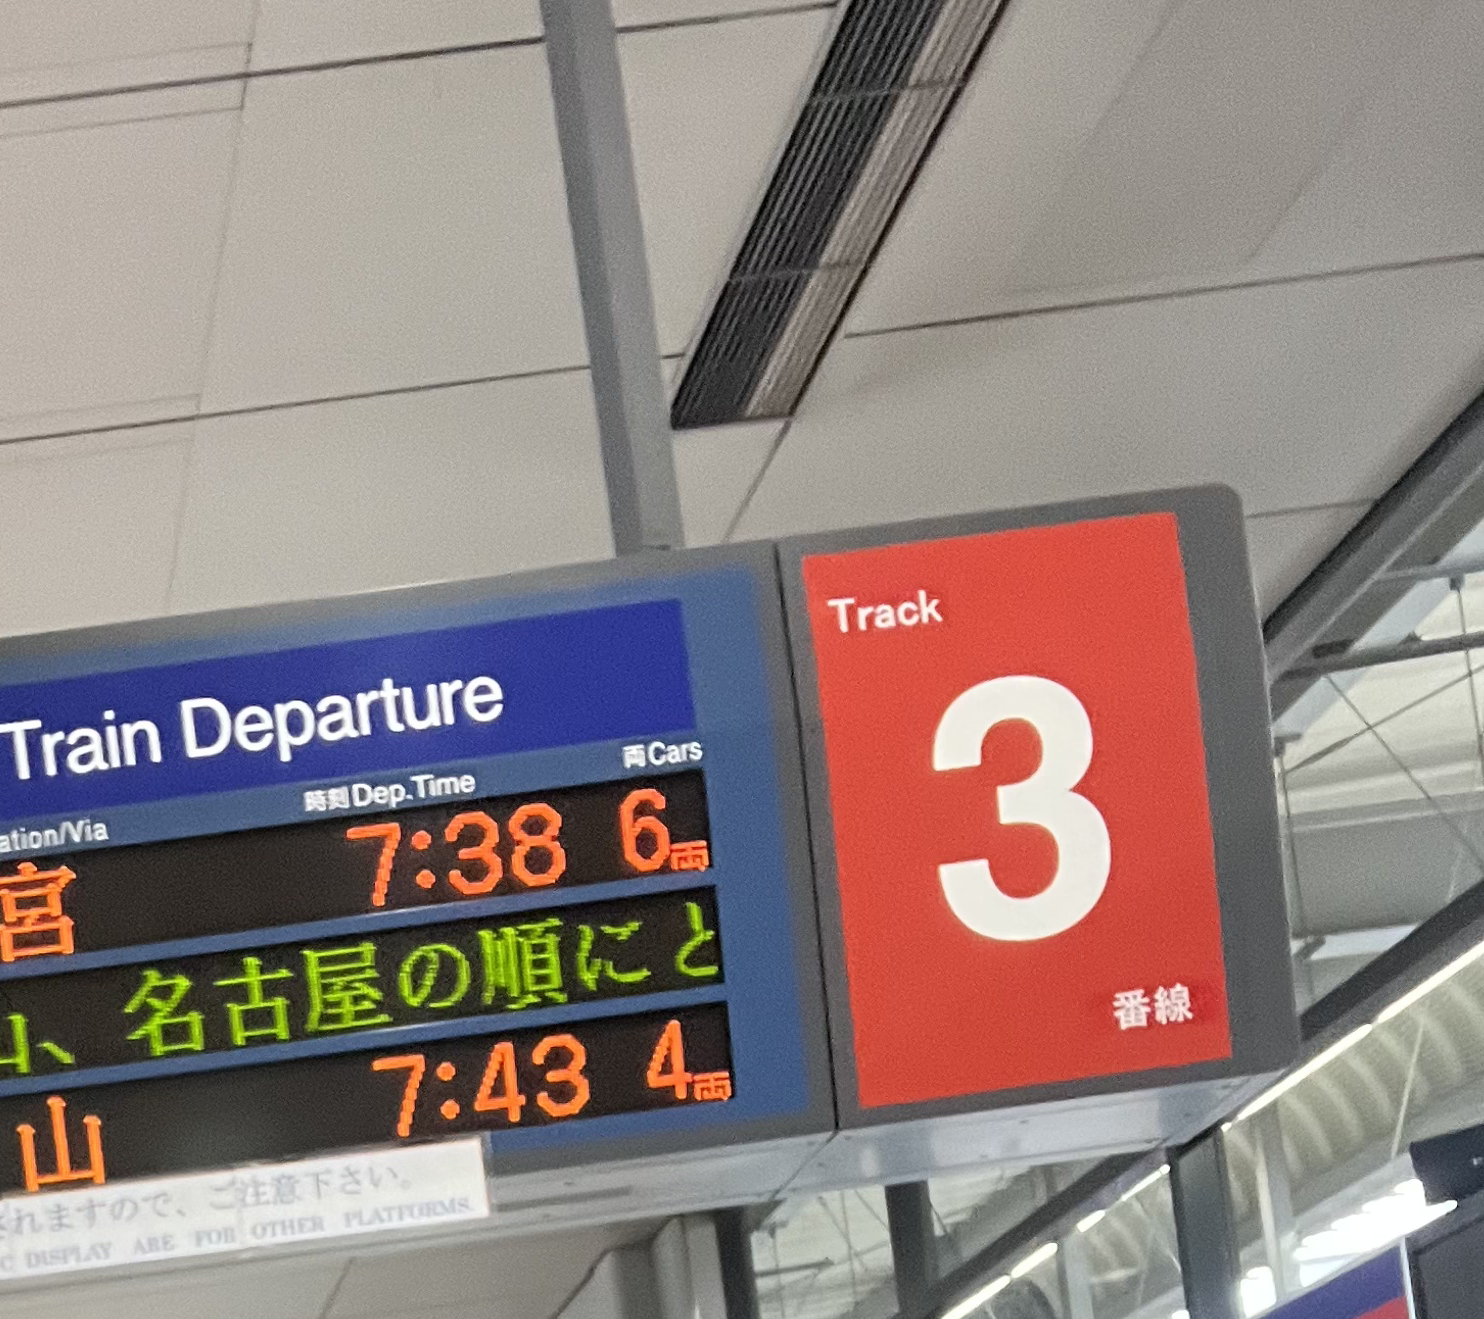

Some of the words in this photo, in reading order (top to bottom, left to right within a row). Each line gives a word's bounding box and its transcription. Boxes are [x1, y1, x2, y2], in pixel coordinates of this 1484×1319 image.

[827, 589, 944, 634] Track
[181, 673, 505, 762] Departure
[932, 674, 1113, 942] 3
[345, 801, 567, 908] 7:38
[1112, 982, 1194, 1031] 番線
[371, 1031, 591, 1139] 7:43
[25, 1241, 114, 1271] DISPLAY
[132, 1232, 177, 1256] ARE
[252, 1212, 327, 1242] OTHER
[342, 1195, 473, 1229] PLATFORMS
